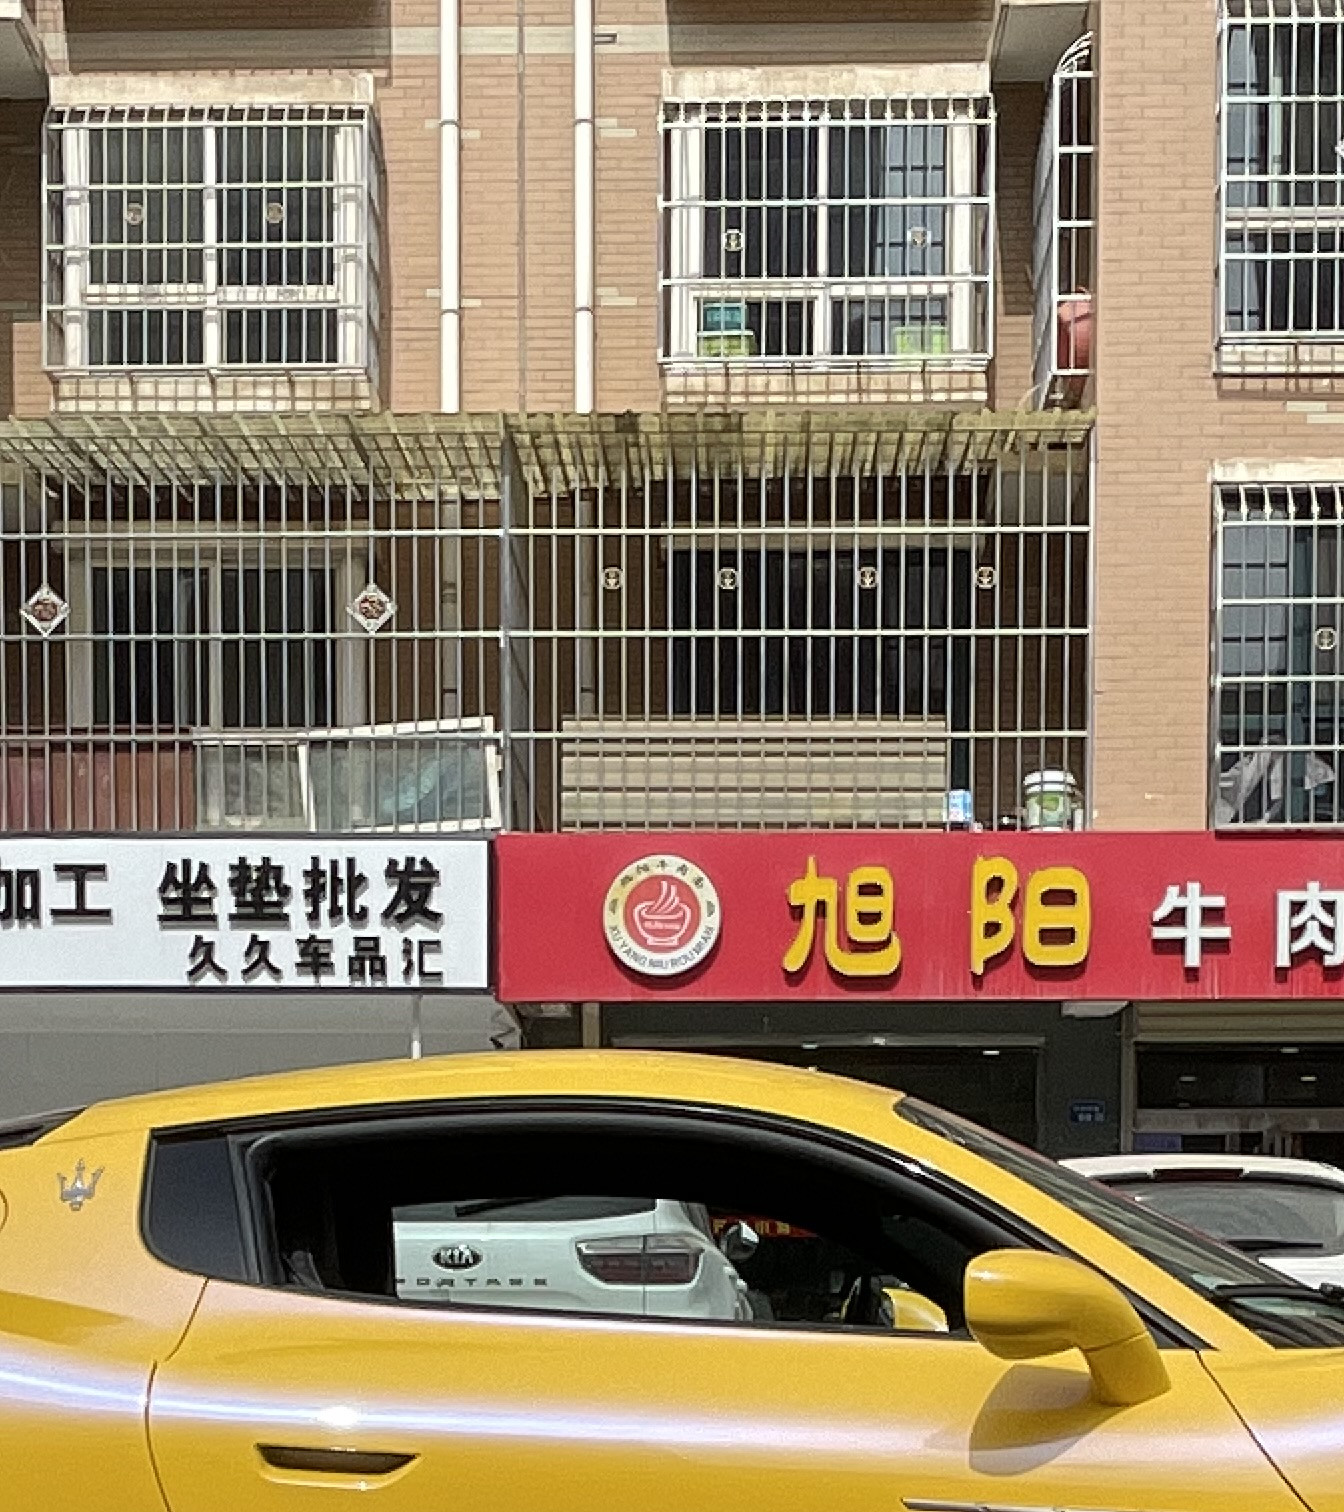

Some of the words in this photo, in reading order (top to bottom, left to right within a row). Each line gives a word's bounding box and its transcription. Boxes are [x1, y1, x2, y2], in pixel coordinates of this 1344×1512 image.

[157, 856, 444, 928] 坐垫批发
[187, 934, 444, 984] 久久车品汇
